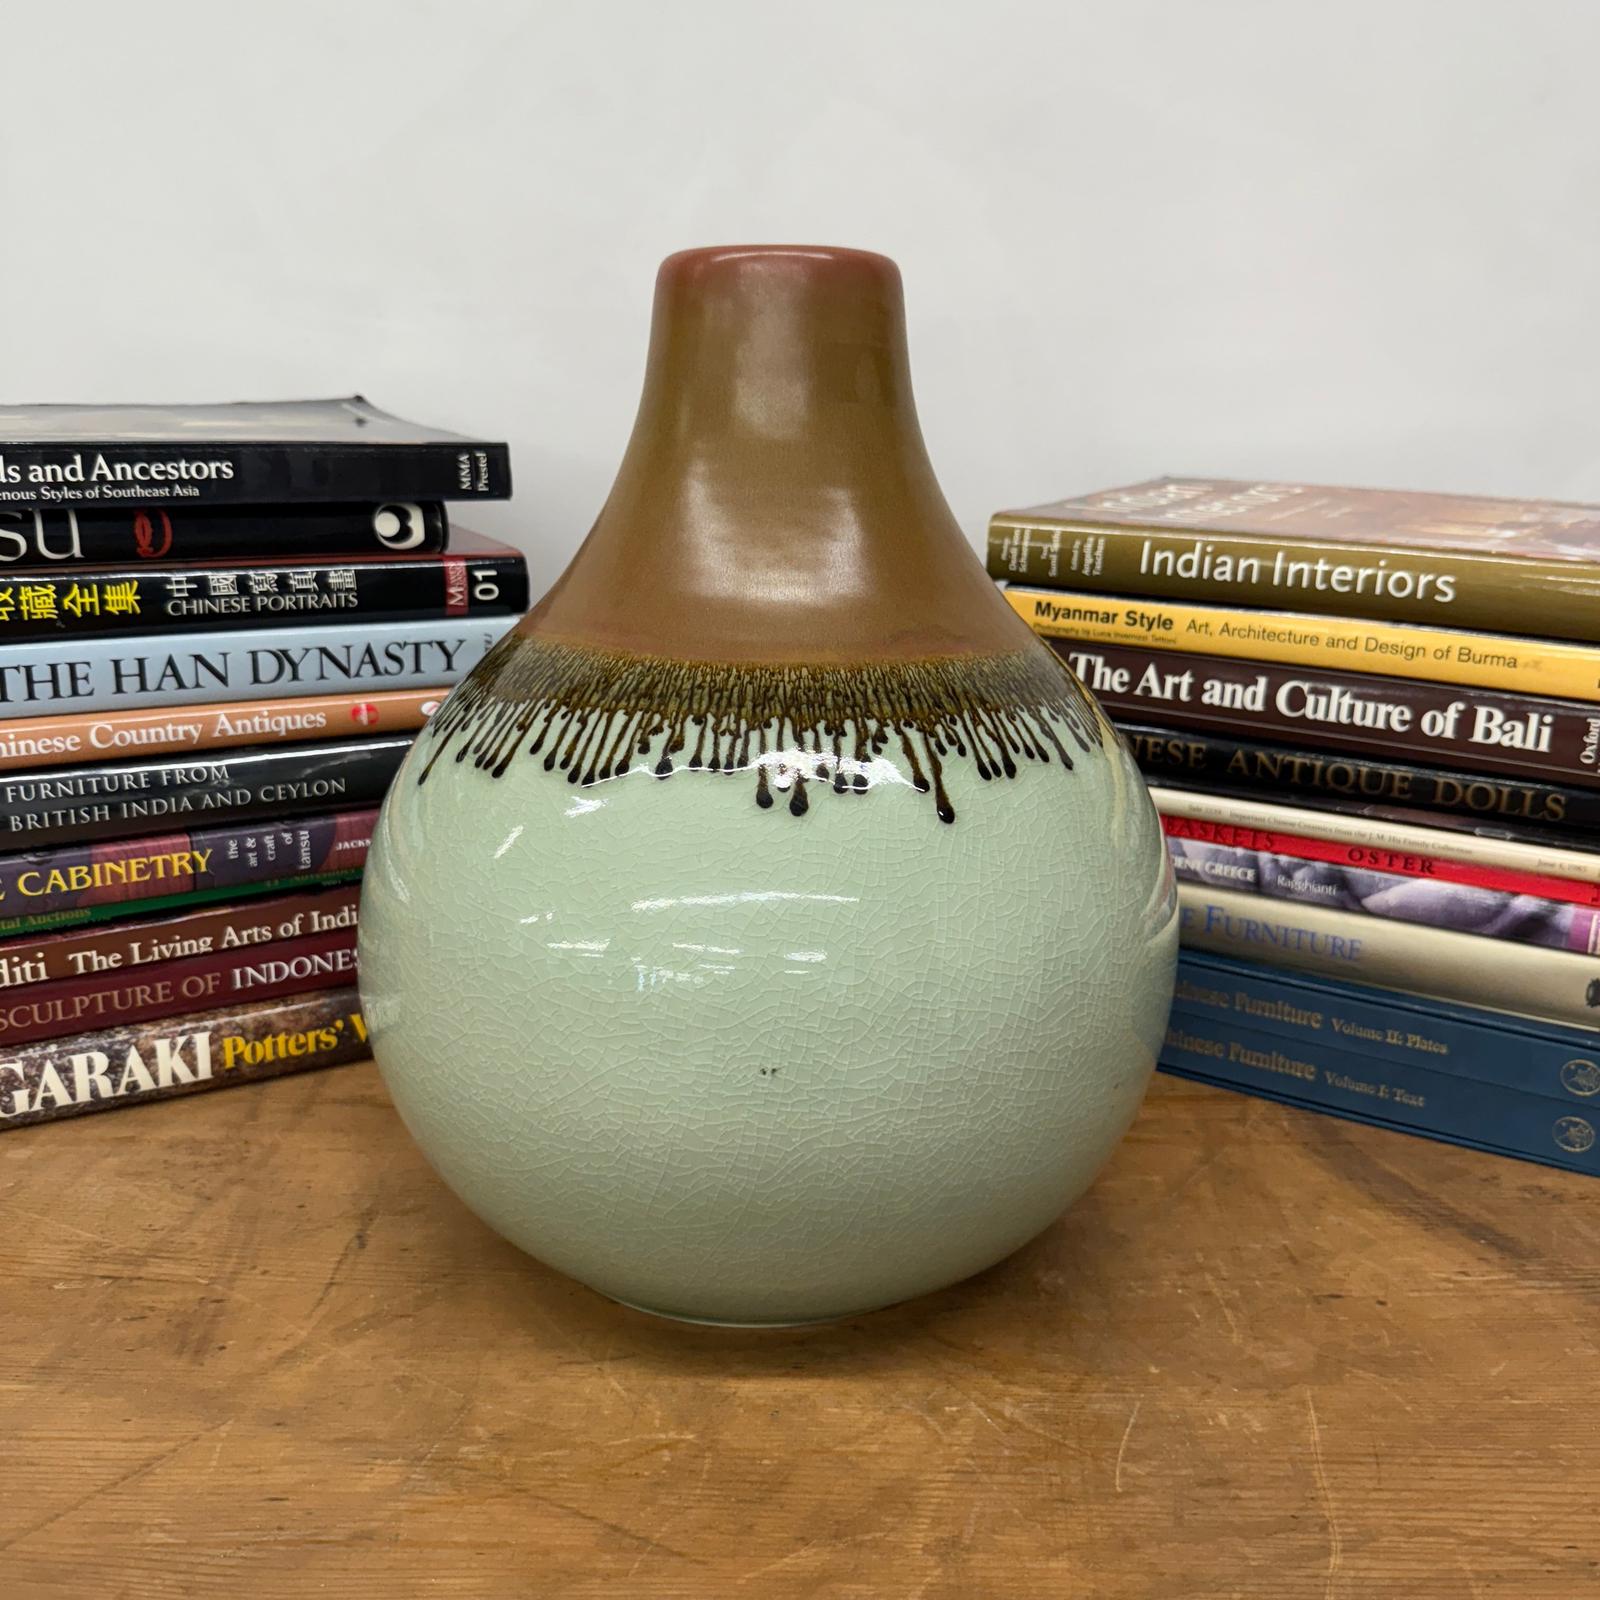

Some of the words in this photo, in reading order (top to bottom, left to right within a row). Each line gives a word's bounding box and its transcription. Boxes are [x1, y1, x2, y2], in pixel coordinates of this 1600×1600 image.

[29, 454, 84, 482] and
[91, 453, 234, 481] Ancestors
[459, 454, 472, 490] MMA
[475, 452, 489, 492] Prestel
[41, 487, 82, 502] Styles
[86, 485, 99, 498] of
[103, 484, 170, 498] Southeast
[173, 484, 199, 496] Asia
[473, 569, 499, 600] 01
[1139, 540, 1259, 584] Indian
[1272, 551, 1456, 602] Interiors
[168, 595, 250, 616] CHINESE
[257, 592, 359, 612] PORTRAITS
[1035, 601, 1118, 625] Myanmar
[1125, 610, 1174, 631] Style
[1186, 619, 1213, 637] Art,
[1219, 622, 1319, 646] Architecture
[1326, 636, 1357, 650] and
[1364, 637, 1426, 660] Design
[1433, 647, 1451, 661] of
[1457, 650, 1517, 668] Burma
[0, 662, 95, 702] THE
[110, 653, 231, 694] HAN
[247, 639, 466, 685] DYNASTY
[1069, 653, 1130, 693] The
[1135, 663, 1194, 702] Art
[1201, 676, 1268, 711] and
[1276, 680, 1412, 732] Culture
[1421, 702, 1466, 739] of
[1469, 705, 1553, 752] Bali
[90, 723, 202, 749] Country
[214, 710, 326, 740] Antiques
[1580, 717, 1600, 764] Oxford
[5, 772, 150, 803] FURNITURE
[161, 765, 229, 786] FROM
[1227, 749, 1413, 799] ANTIQUE
[1434, 776, 1567, 821] DOLLS
[9, 805, 110, 832] BRITISH
[122, 796, 193, 819] INDIA
[200, 789, 251, 810] AND
[260, 778, 346, 801] CEYLON
[228, 840, 239, 859] the
[246, 837, 257, 848] &
[264, 834, 276, 861] craft
[281, 832, 293, 845] of
[299, 831, 312, 870] tansu
[17, 849, 213, 896] CABINETRY
[248, 851, 258, 868] art
[1205, 862, 1256, 882] GREECE
[1347, 848, 1435, 875] OSTER
[1277, 875, 1337, 896] Ragghianti
[25, 909, 92, 927] Auctions
[68, 950, 123, 974] The
[130, 935, 214, 965] Living
[221, 926, 273, 949] Arts
[279, 913, 304, 938] of
[182, 973, 221, 998] OF
[1235, 992, 1324, 1029] Furniture
[1332, 1017, 1383, 1041] Volume
[1406, 1033, 1449, 1055] Plates
[0, 1031, 213, 1118] GARAKI
[1229, 1042, 1317, 1080] Furniture
[1325, 1071, 1376, 1095] Volume
[1393, 1088, 1425, 1107] Text
